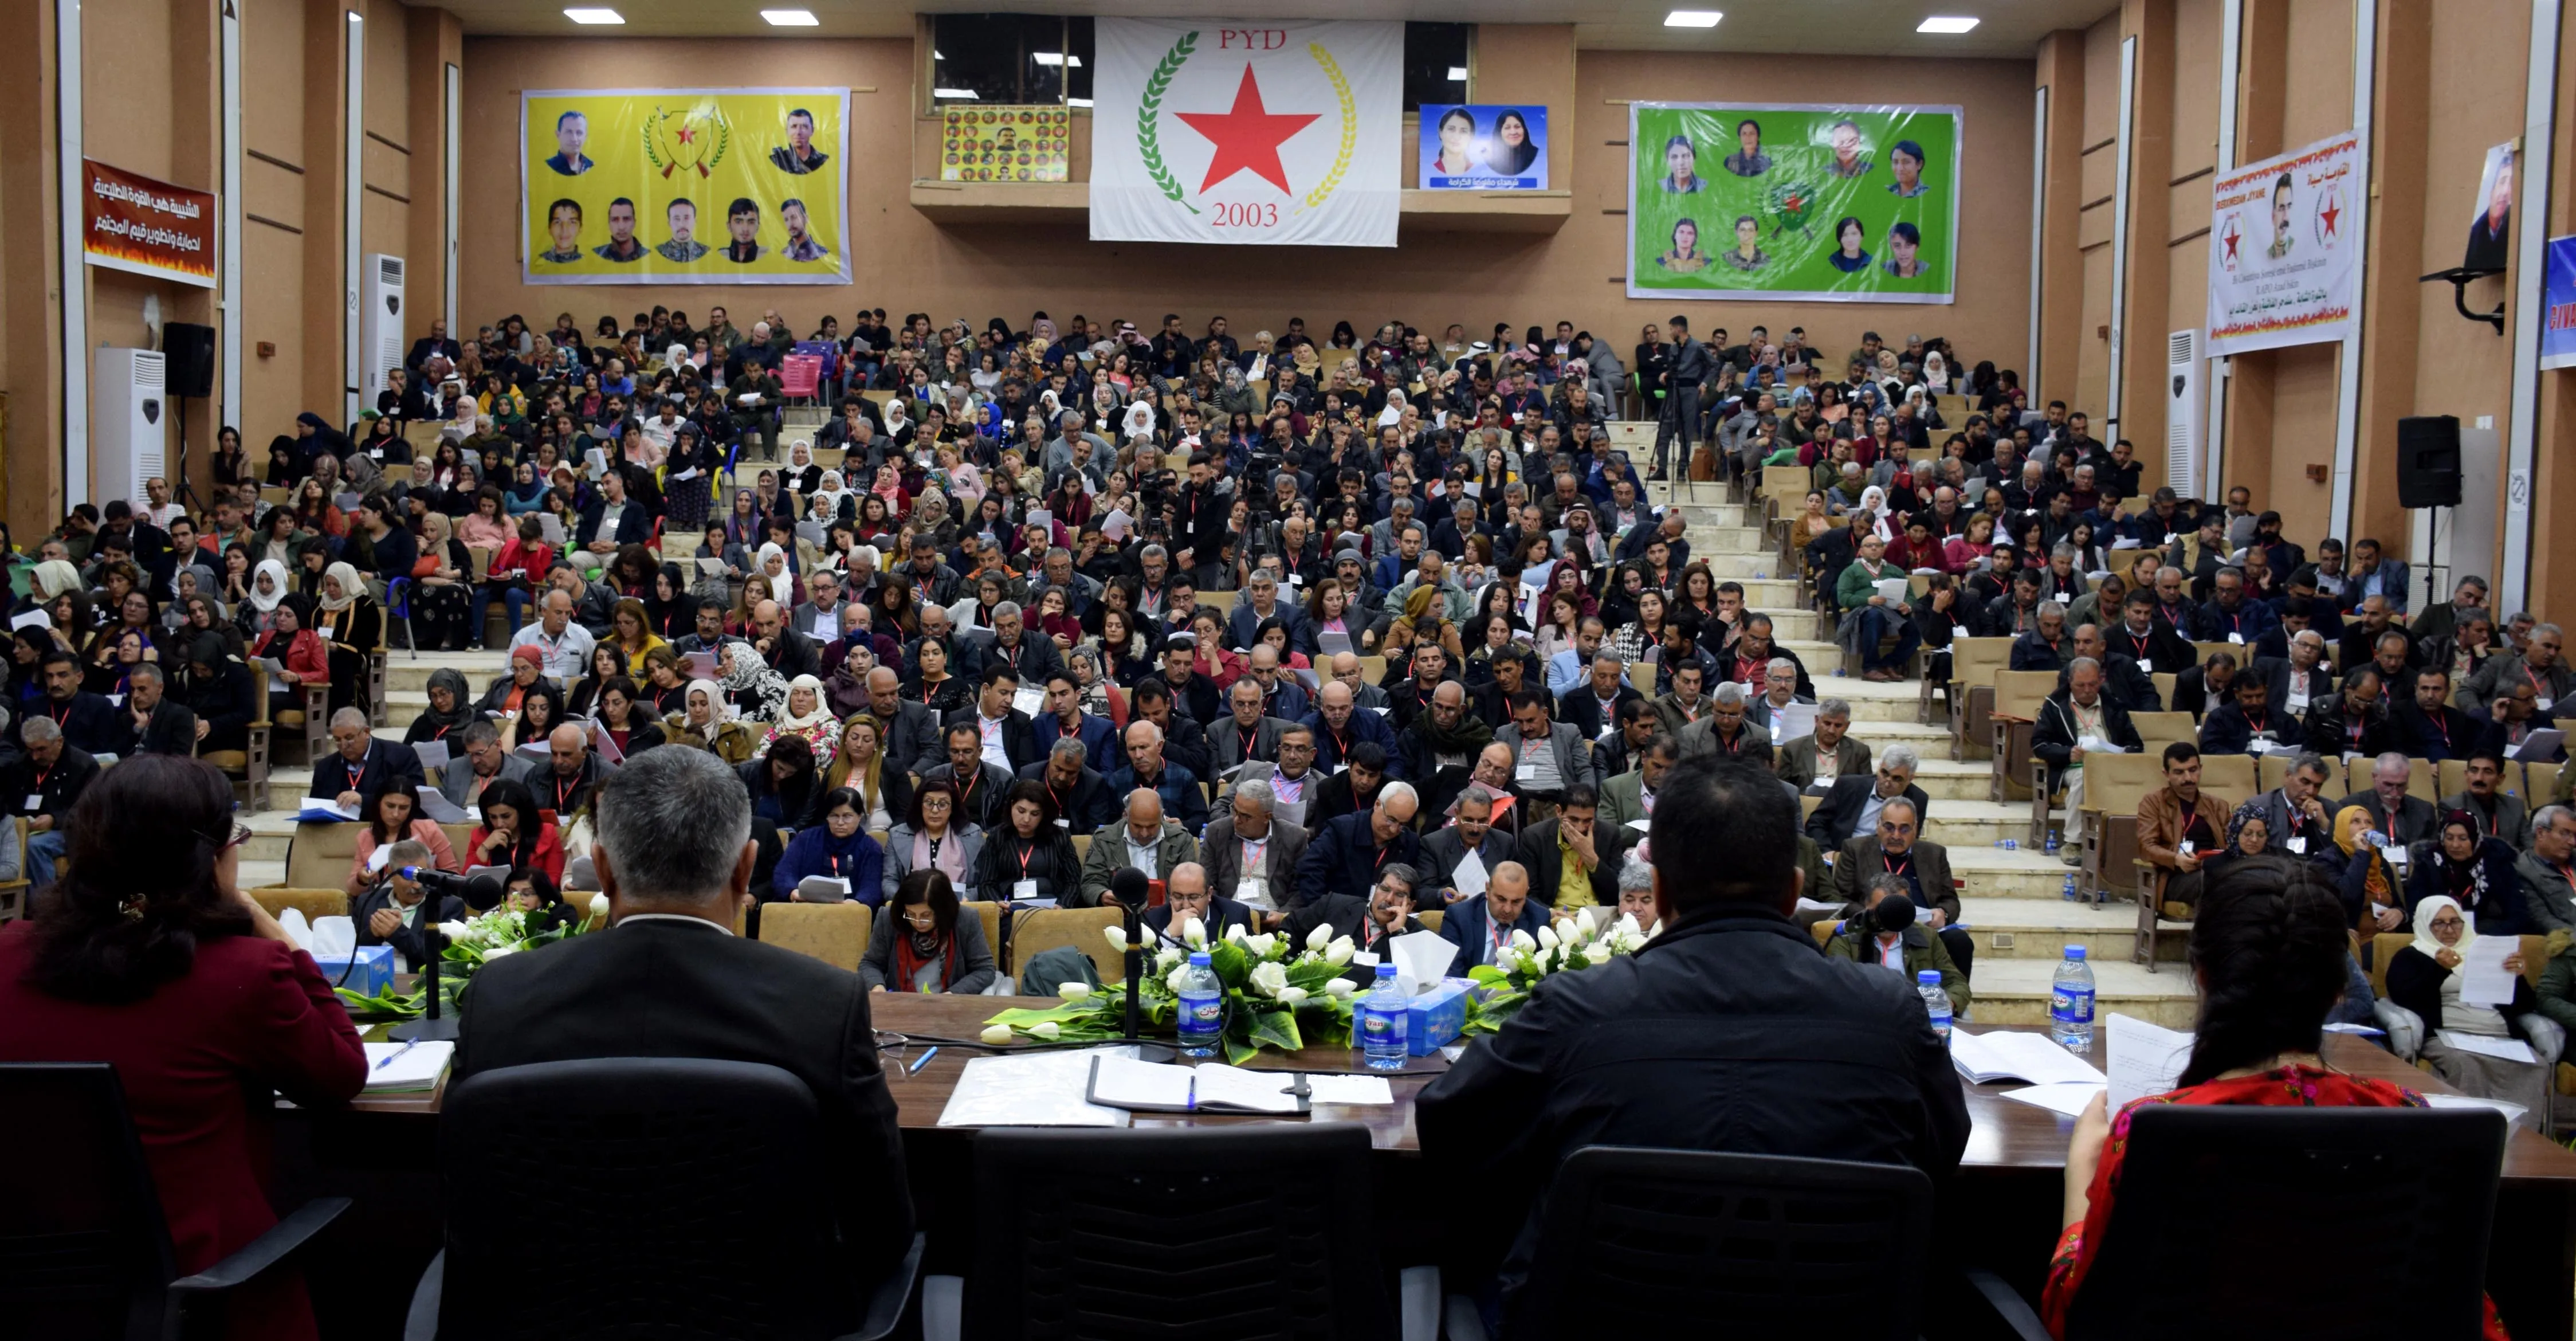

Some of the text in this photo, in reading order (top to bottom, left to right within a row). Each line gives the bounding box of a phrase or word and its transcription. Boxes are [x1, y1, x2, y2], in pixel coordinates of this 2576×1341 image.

[1219, 29, 1286, 50] PYD
[93, 177, 199, 219] الشبيبة هي القوة الطليعية
[1212, 203, 1278, 228] 2003
[95, 215, 201, 251] لحماية وتطوير قيم المجتمع
